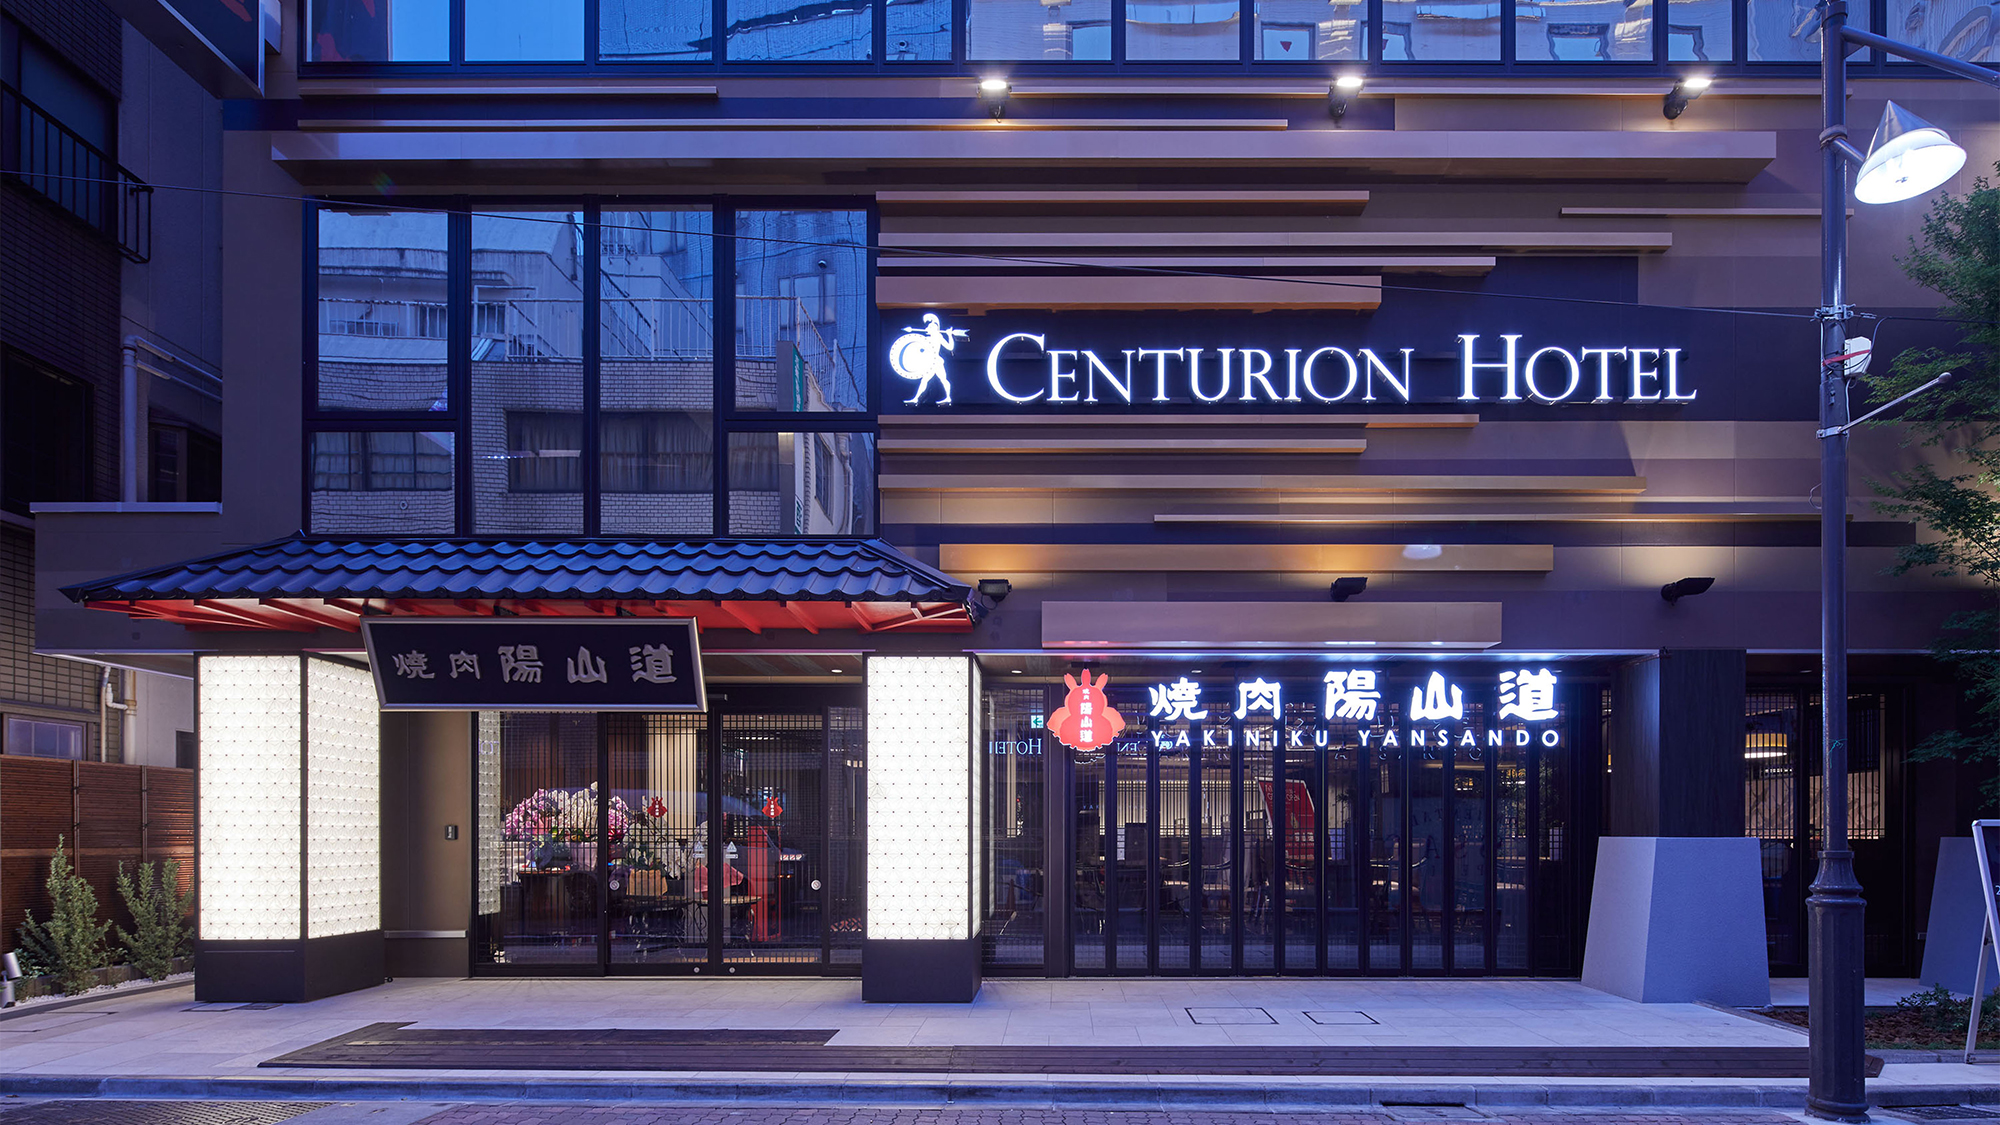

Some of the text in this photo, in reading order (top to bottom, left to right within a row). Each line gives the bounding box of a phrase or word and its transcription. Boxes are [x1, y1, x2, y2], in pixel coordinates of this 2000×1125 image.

[987, 332, 1697, 402] CENTURION HOTEL
[1150, 729, 1329, 748] YAKINIKU
[1357, 729, 1560, 748] YANSANDO
